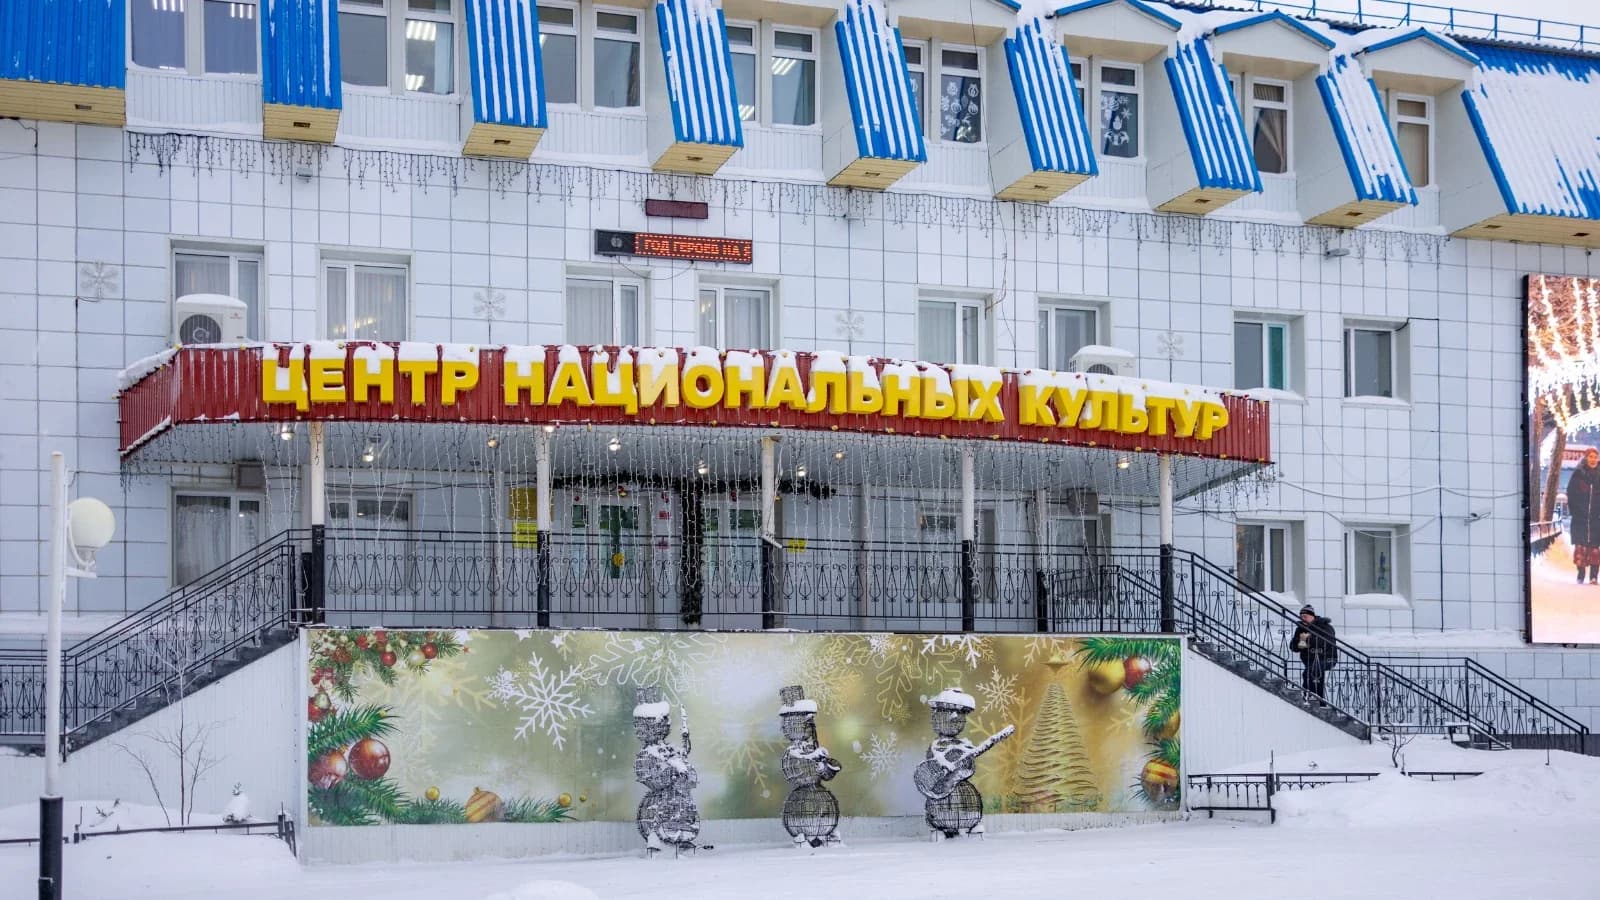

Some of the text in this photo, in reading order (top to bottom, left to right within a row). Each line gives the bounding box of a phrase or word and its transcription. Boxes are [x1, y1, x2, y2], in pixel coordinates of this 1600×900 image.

[644, 239, 670, 254] ГОД
[722, 244, 741, 256] НА
[262, 357, 1230, 441] ЦЕНТР НАЦИОНАЛЬНЫХ КУЛЬТУР
